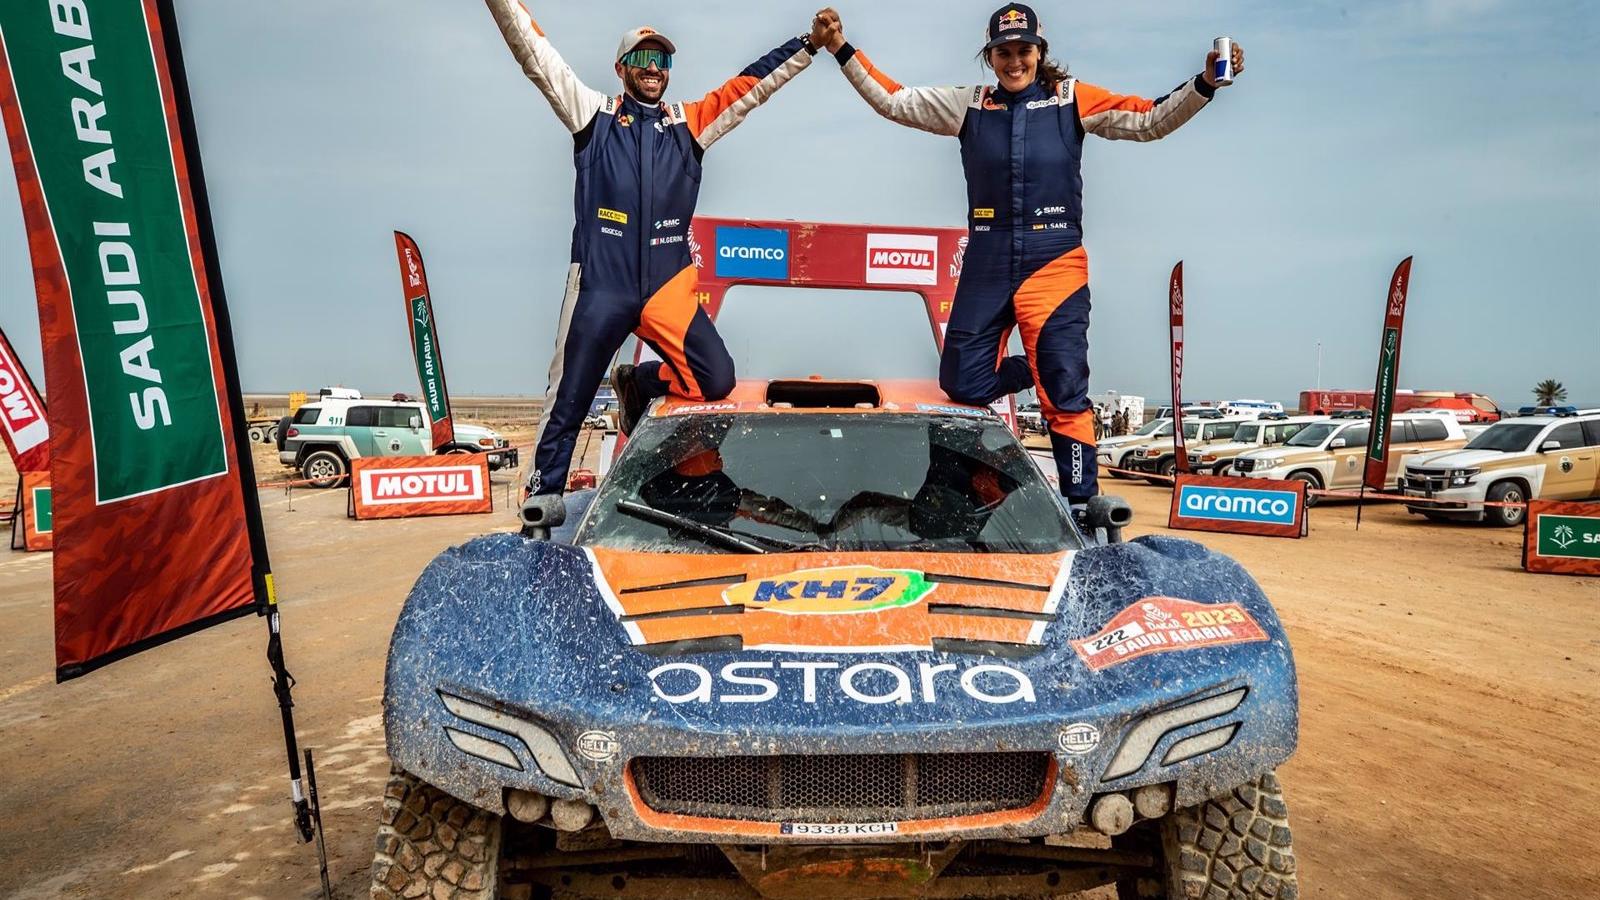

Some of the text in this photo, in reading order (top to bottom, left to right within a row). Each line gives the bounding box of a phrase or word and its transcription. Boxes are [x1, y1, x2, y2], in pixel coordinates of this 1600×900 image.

[662, 219, 680, 227] SMC
[719, 245, 784, 261] aramco
[872, 251, 931, 267] MOTUL
[93, 222, 172, 430] SAUDI
[423, 332, 440, 412] SAUDI ARABIA
[672, 403, 736, 413] MOTUL
[328, 416, 343, 425] 911
[1072, 442, 1082, 484] sparco
[376, 474, 469, 496] MOTUL
[1186, 493, 1289, 516] aramco
[753, 577, 896, 601] KH-7
[1181, 608, 1246, 627] 2023
[1092, 629, 1130, 651] 222
[1114, 625, 1234, 655] SAUDI ARABIA
[647, 662, 1036, 704] astara
[1062, 731, 1100, 744] HELLA
[797, 825, 849, 834] 9338
